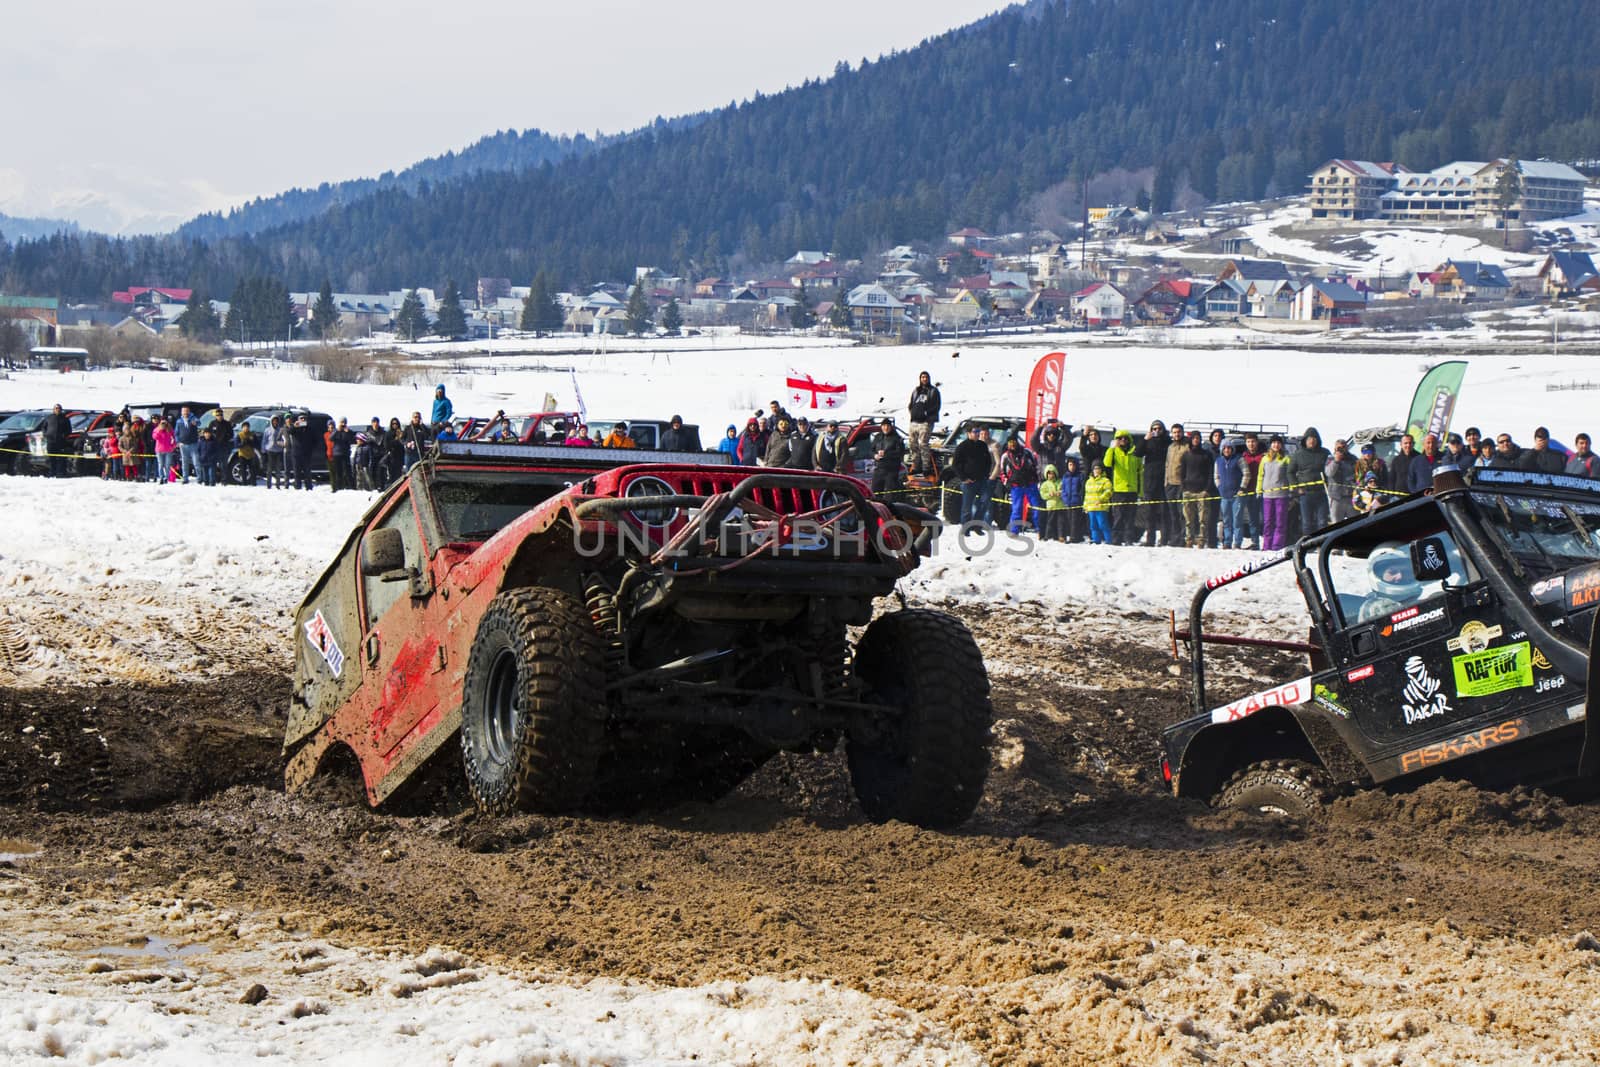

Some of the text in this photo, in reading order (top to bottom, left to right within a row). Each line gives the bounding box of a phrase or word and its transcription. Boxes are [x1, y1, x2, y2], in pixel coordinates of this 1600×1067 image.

[1464, 652, 1517, 683] RAPTOR
[1536, 675, 1565, 693] Jeep
[1402, 693, 1453, 725] DAKAR
[1401, 720, 1520, 773] FISKARS
